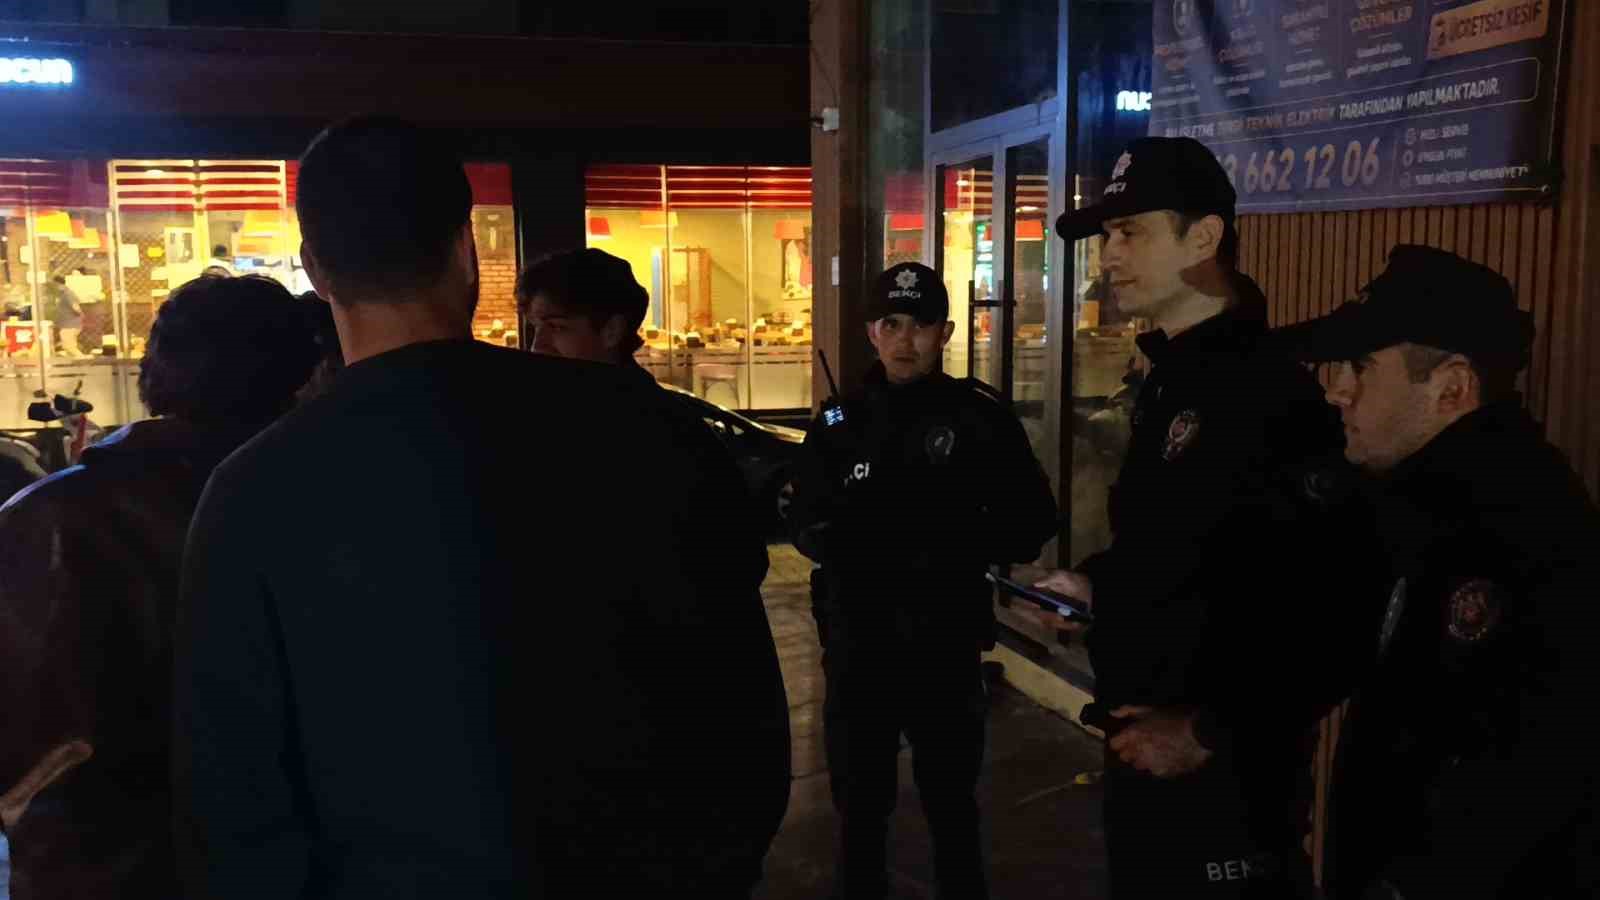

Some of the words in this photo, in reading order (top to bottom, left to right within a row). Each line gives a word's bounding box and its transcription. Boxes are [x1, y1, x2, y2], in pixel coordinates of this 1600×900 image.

[1245, 147, 1295, 193] 662
[1304, 143, 1337, 190] 12
[1342, 137, 1381, 186] 06
